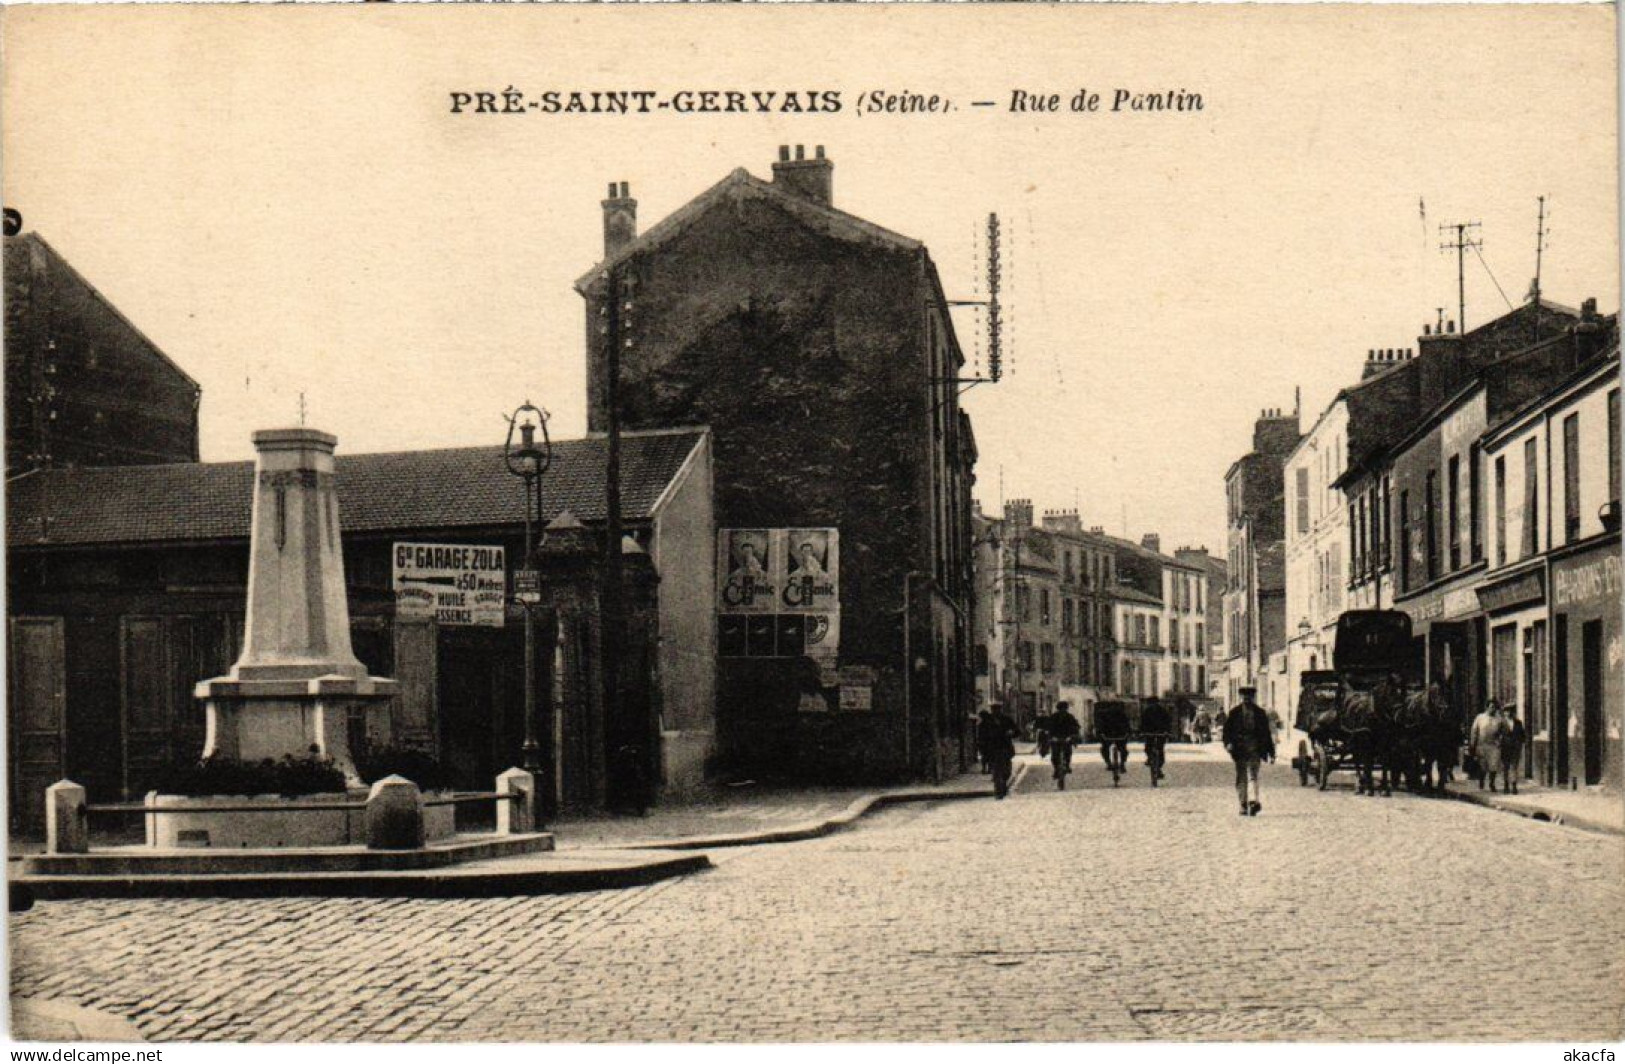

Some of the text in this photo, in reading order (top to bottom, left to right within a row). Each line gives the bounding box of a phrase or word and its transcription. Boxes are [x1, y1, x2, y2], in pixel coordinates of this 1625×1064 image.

[415, 546, 469, 570] GARAGE
[470, 549, 503, 571] ZOLA
[437, 592, 466, 607] HUILE
[435, 609, 472, 623] ESSENCE
